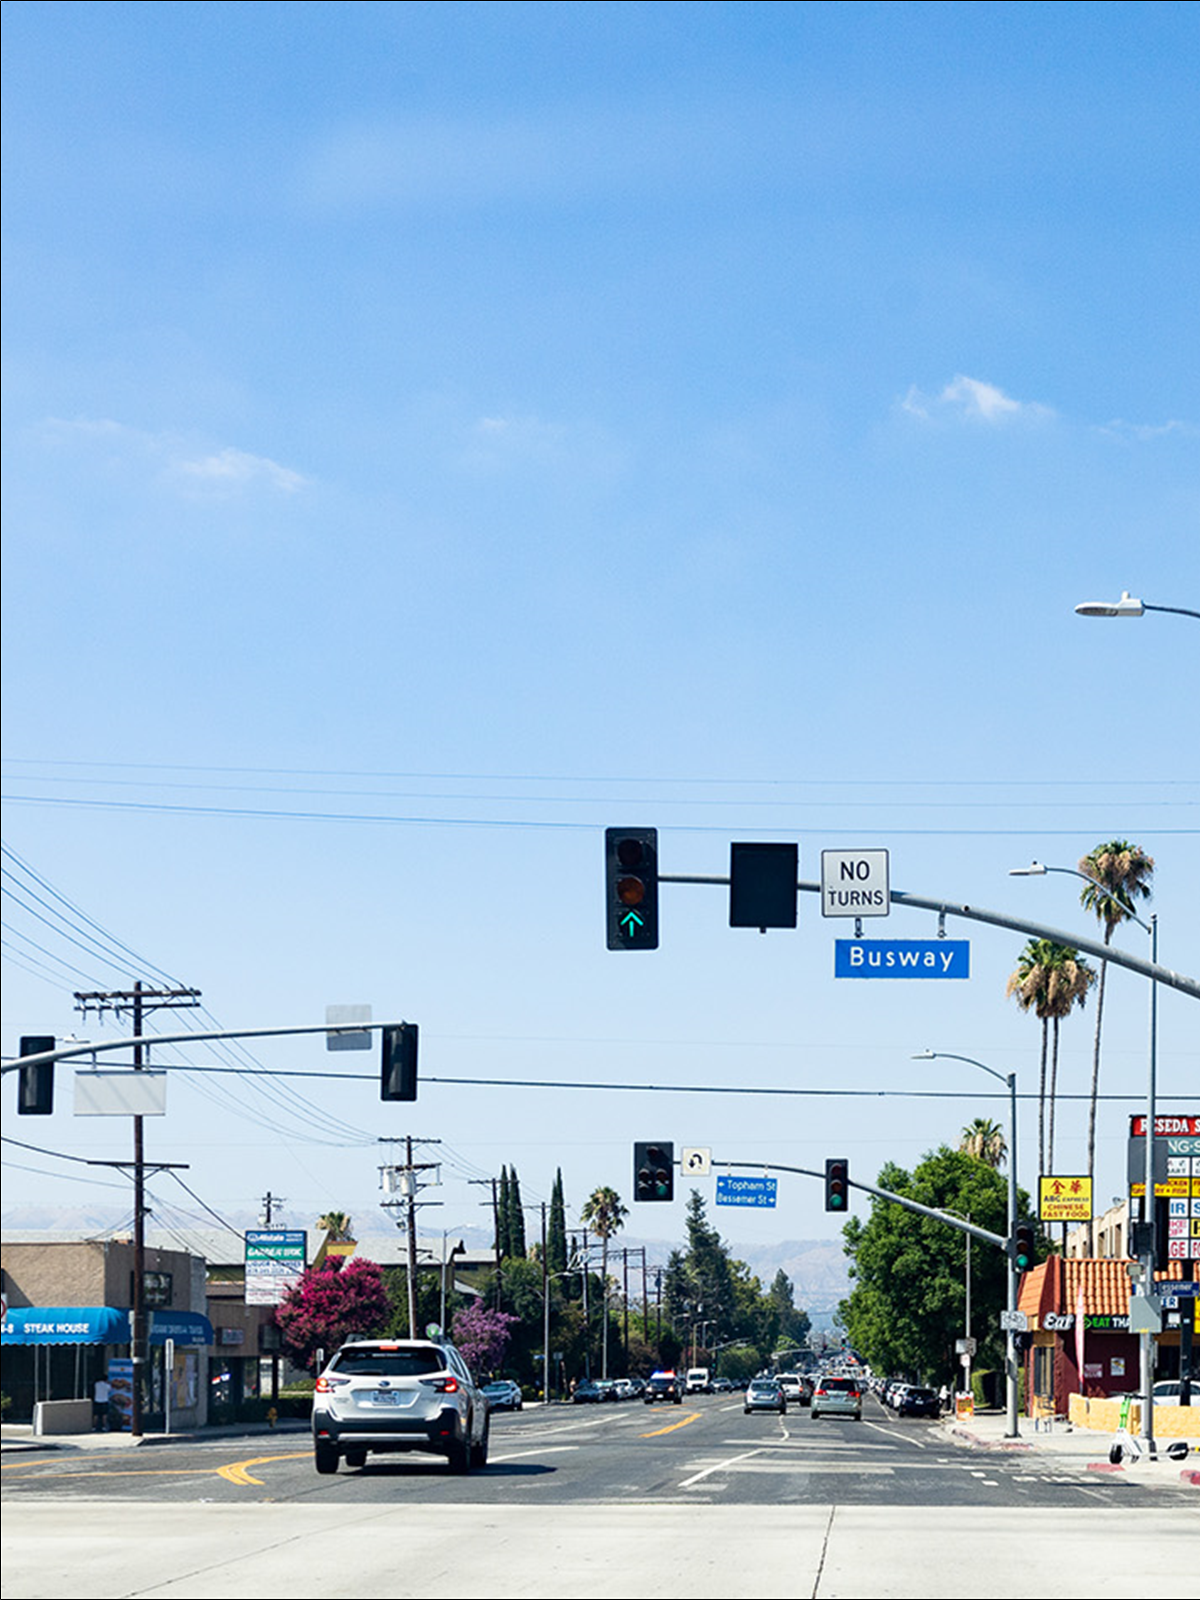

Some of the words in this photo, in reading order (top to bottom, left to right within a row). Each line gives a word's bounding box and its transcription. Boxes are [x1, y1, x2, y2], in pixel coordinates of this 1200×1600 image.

[840, 860, 870, 881] NO
[828, 890, 884, 906] TURNS
[850, 946, 954, 972] Busway
[1140, 1118, 1189, 1133] RSEDA
[727, 1179, 764, 1192] Topham
[765, 1182, 777, 1192] St
[717, 1194, 756, 1204] Bessemer
[757, 1195, 768, 1205] St
[1047, 1203, 1085, 1211] CHINESE
[1042, 1210, 1064, 1218] FAST
[1066, 1210, 1090, 1218] FOOD
[1092, 1317, 1111, 1327] EAT
[23, 1323, 55, 1334] STEAK
[56, 1323, 90, 1334] HOUSE
